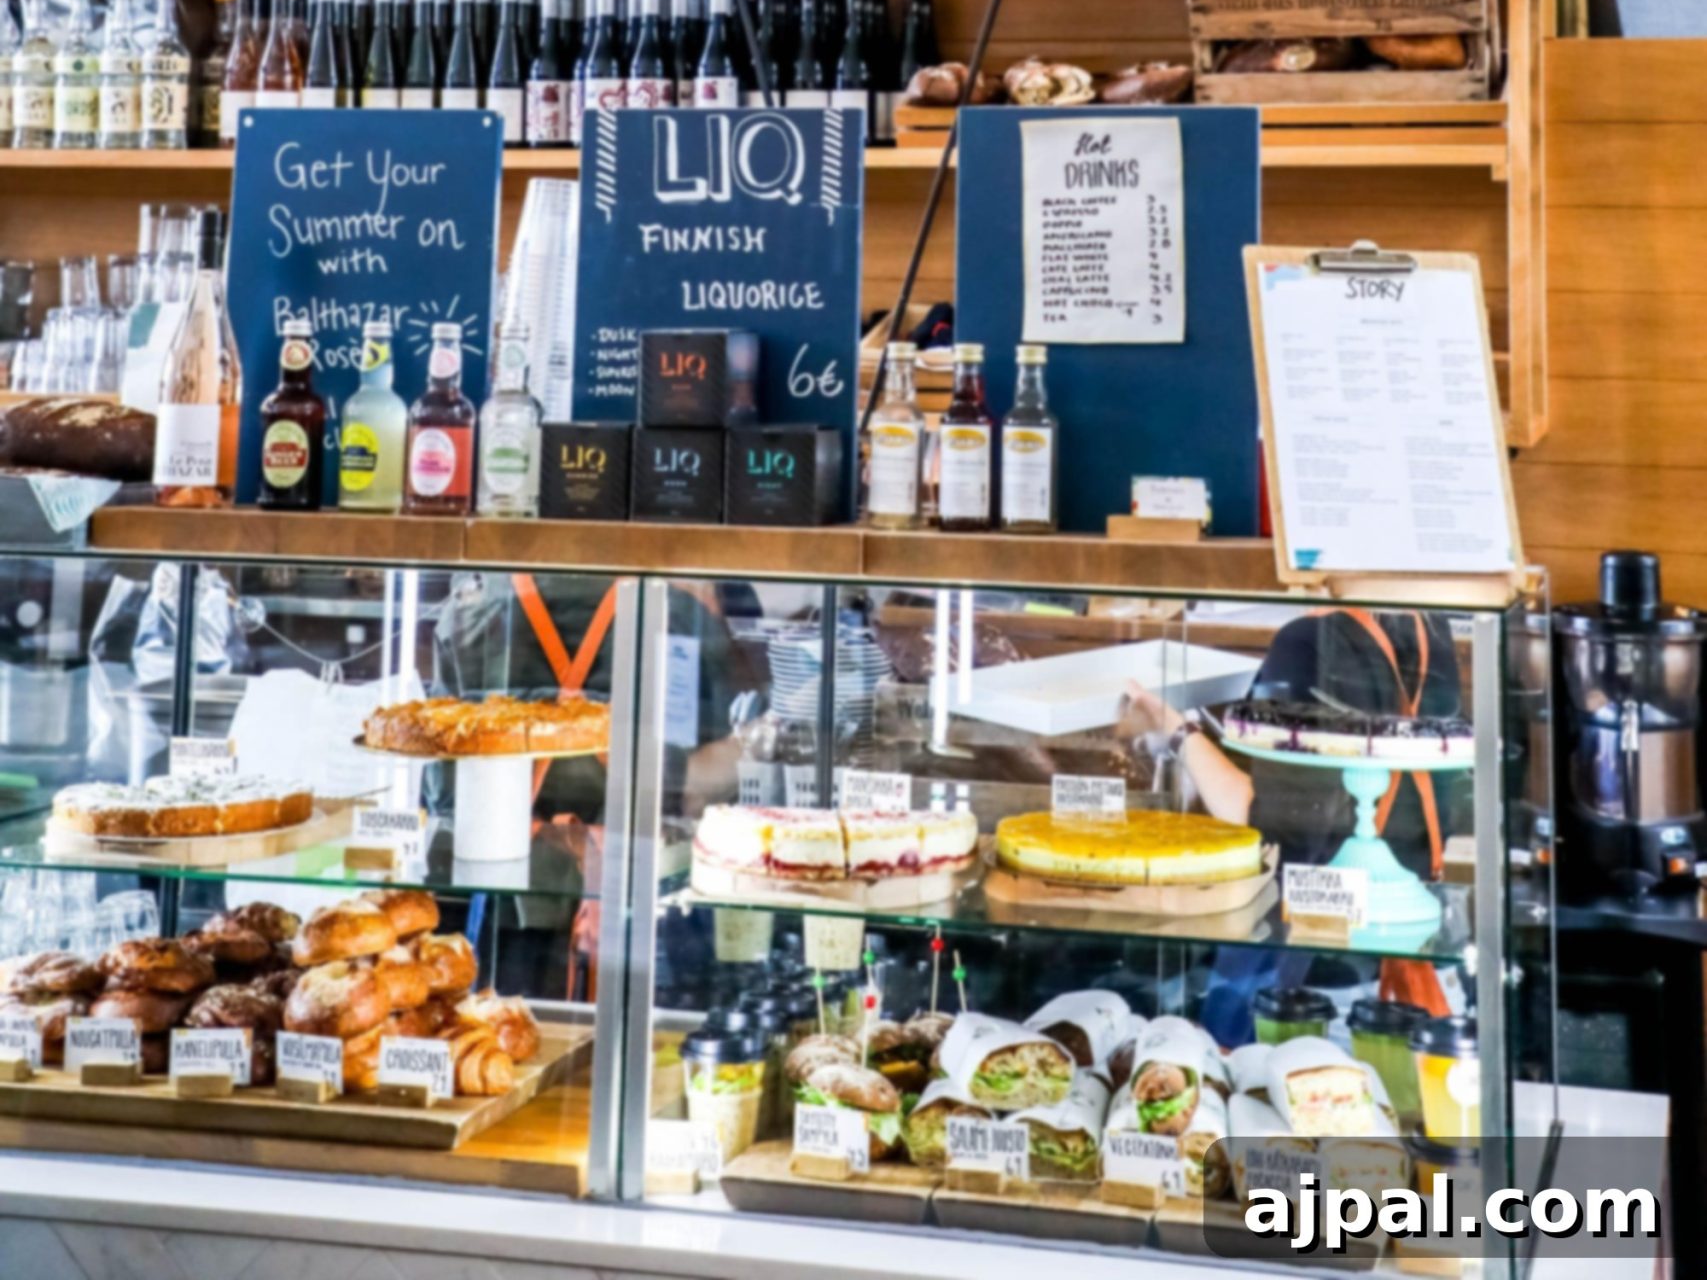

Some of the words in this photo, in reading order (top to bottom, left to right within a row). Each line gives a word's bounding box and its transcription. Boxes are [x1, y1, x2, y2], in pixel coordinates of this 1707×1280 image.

[273, 142, 353, 190] Get
[653, 111, 805, 205] LIQ
[1064, 158, 1139, 189] DRINKS
[268, 204, 404, 258] Summer
[418, 217, 466, 250] on
[639, 224, 766, 253] FINNISH
[318, 249, 387, 275] with
[681, 280, 824, 311] LIQUORICE
[1345, 276, 1405, 302] STORY
[272, 296, 410, 336] Balthazar
[660, 352, 706, 381] LIQ
[788, 344, 843, 397] 6€
[561, 444, 606, 473] LIQ
[654, 447, 700, 476] LIQ
[747, 448, 795, 479] LIQ
